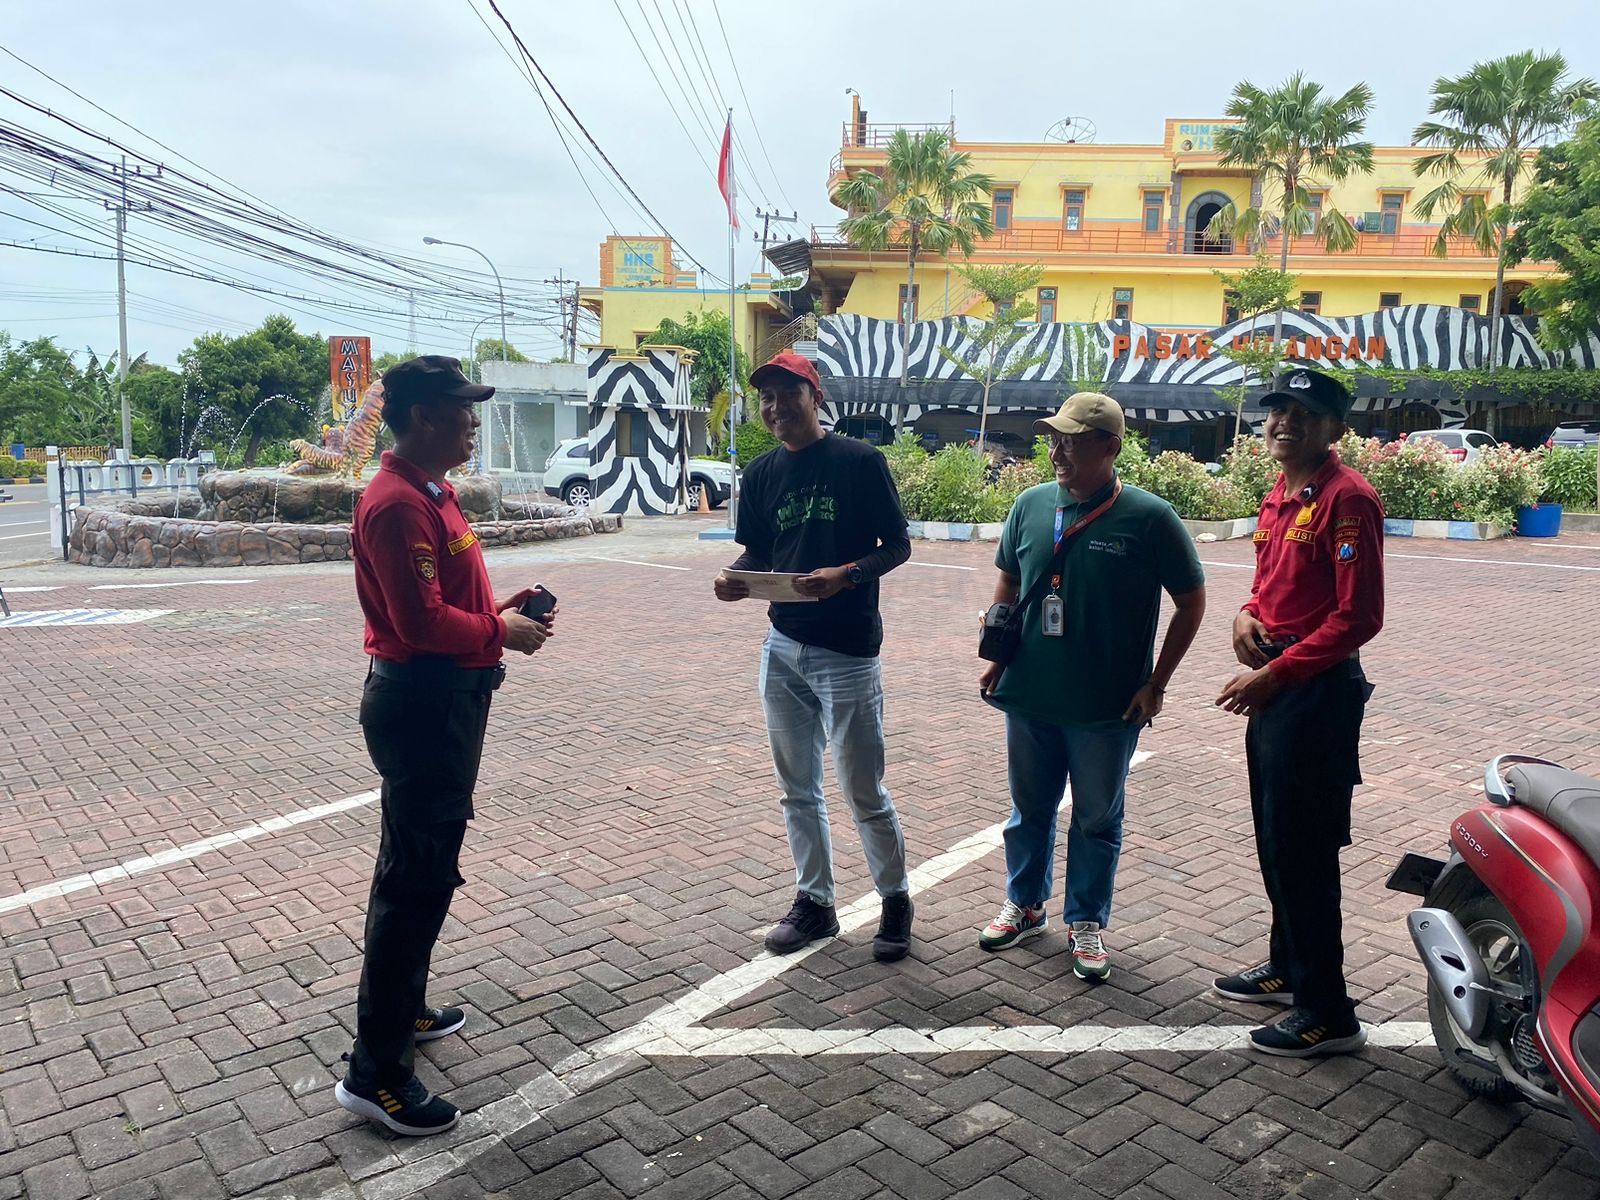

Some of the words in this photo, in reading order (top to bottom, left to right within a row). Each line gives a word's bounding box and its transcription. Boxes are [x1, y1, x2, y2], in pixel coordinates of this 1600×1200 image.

[1113, 335, 1212, 360] PASAR
[340, 339, 359, 421] MASUK
[1456, 822, 1489, 857] SCOOPY
